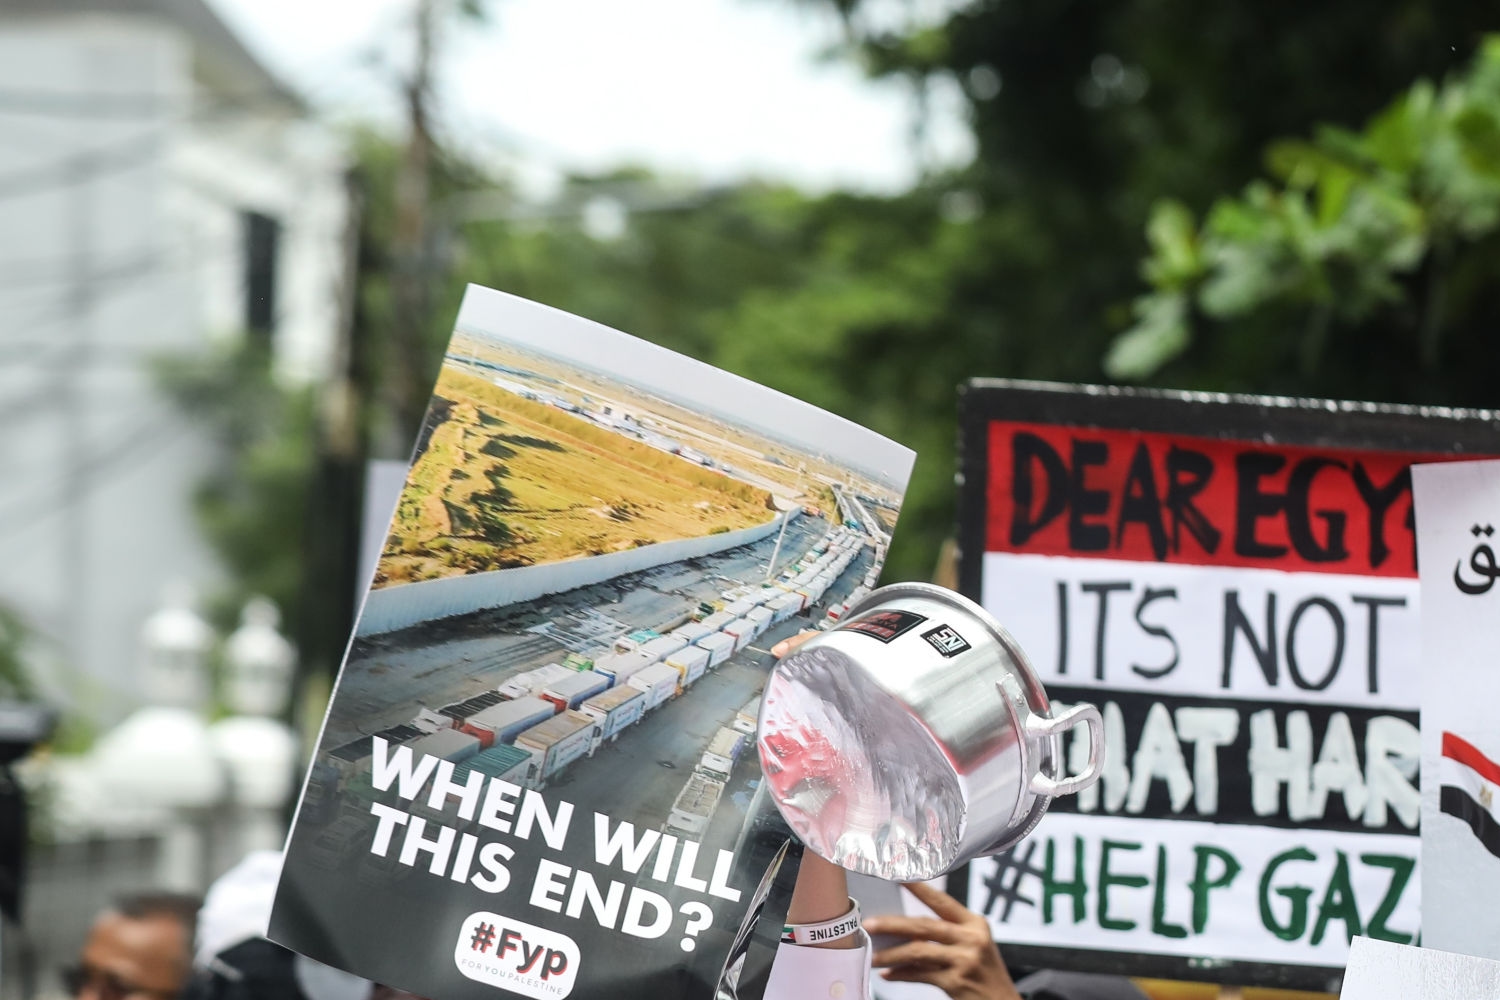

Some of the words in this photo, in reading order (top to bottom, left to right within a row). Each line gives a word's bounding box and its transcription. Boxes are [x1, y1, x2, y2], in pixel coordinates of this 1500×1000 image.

[1009, 429, 1221, 562] DEAR
[1233, 451, 1419, 570] EGY
[1056, 580, 1181, 681] ITS
[1220, 589, 1406, 695] NOT
[371, 735, 575, 851] WHEN
[593, 811, 742, 902] WILL
[370, 802, 516, 894] THIS
[529, 858, 714, 953] END?
[810, 917, 859, 941] PALESTINE
[981, 836, 1241, 930] #HELP
[1257, 848, 1420, 947] GAZ
[461, 958, 482, 971] FOR
[484, 966, 506, 978] YOU
[508, 972, 563, 996] PALESTINE
[470, 921, 569, 982] #Fyp
